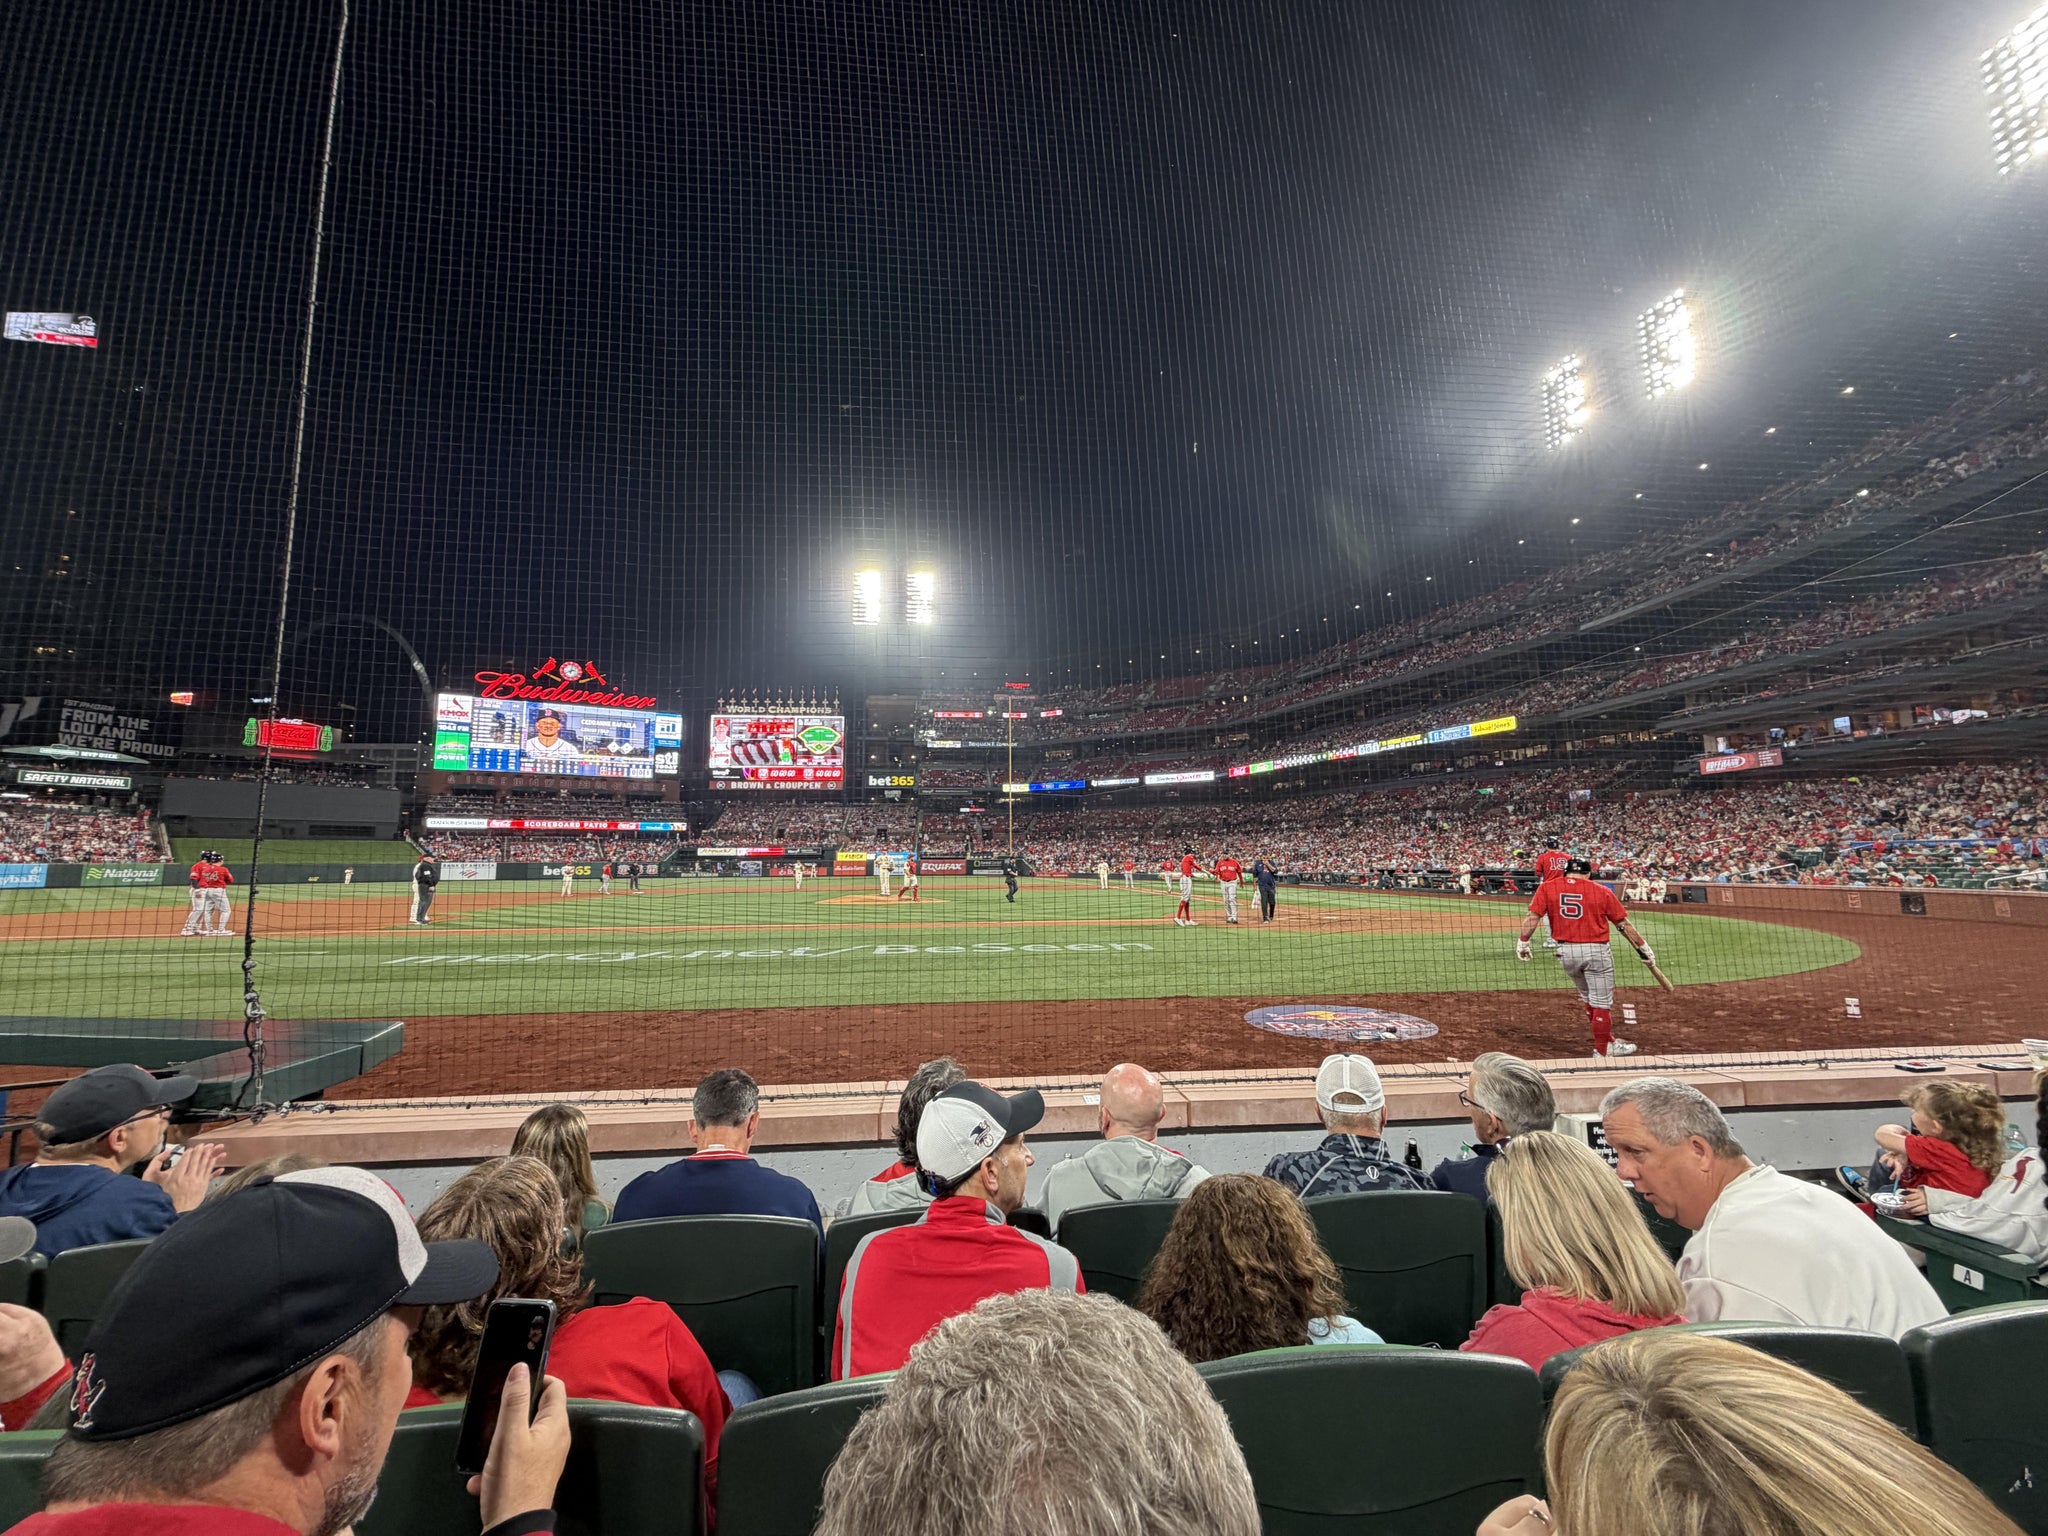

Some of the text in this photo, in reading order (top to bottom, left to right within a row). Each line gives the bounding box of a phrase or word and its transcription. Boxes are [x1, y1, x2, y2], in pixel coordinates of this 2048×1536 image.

[474, 671, 656, 709] Budweiser
[439, 709, 470, 717] KMOX
[726, 705, 832, 714] WORLD CHAMPIONS
[61, 708, 150, 730] FROM THE
[60, 720, 136, 740] LOU AND
[59, 733, 175, 756] WE'RE PROUD
[24, 773, 126, 786] SAFETY NATIONAL
[868, 775, 914, 786] bet365
[731, 781, 764, 789] BROWN
[774, 781, 821, 790] CROUPPEN
[104, 867, 159, 878] National
[543, 865, 591, 876] be65
[921, 863, 962, 872] EQUIFAX
[1560, 893, 1583, 919] 5
[1593, 1126, 1606, 1135] Plea
[1963, 1269, 1972, 1284] A
